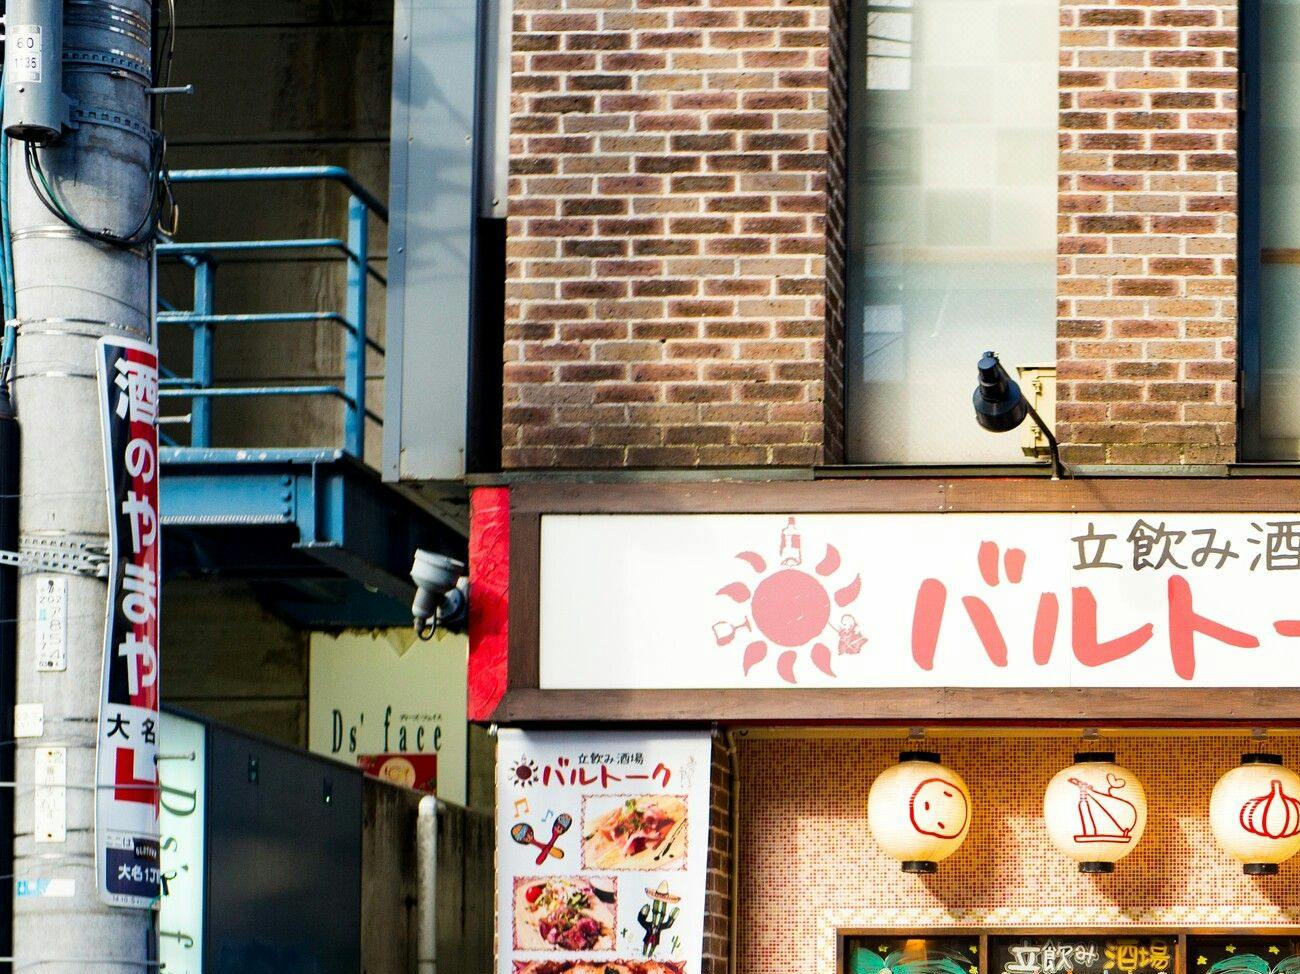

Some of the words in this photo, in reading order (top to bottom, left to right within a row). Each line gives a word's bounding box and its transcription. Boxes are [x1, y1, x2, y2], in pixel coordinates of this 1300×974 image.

[113, 357, 158, 696] 酒のやまや
[384, 705, 441, 752] face
[542, 757, 671, 789] バルトーク
[577, 752, 644, 765] 立飲み酒場
